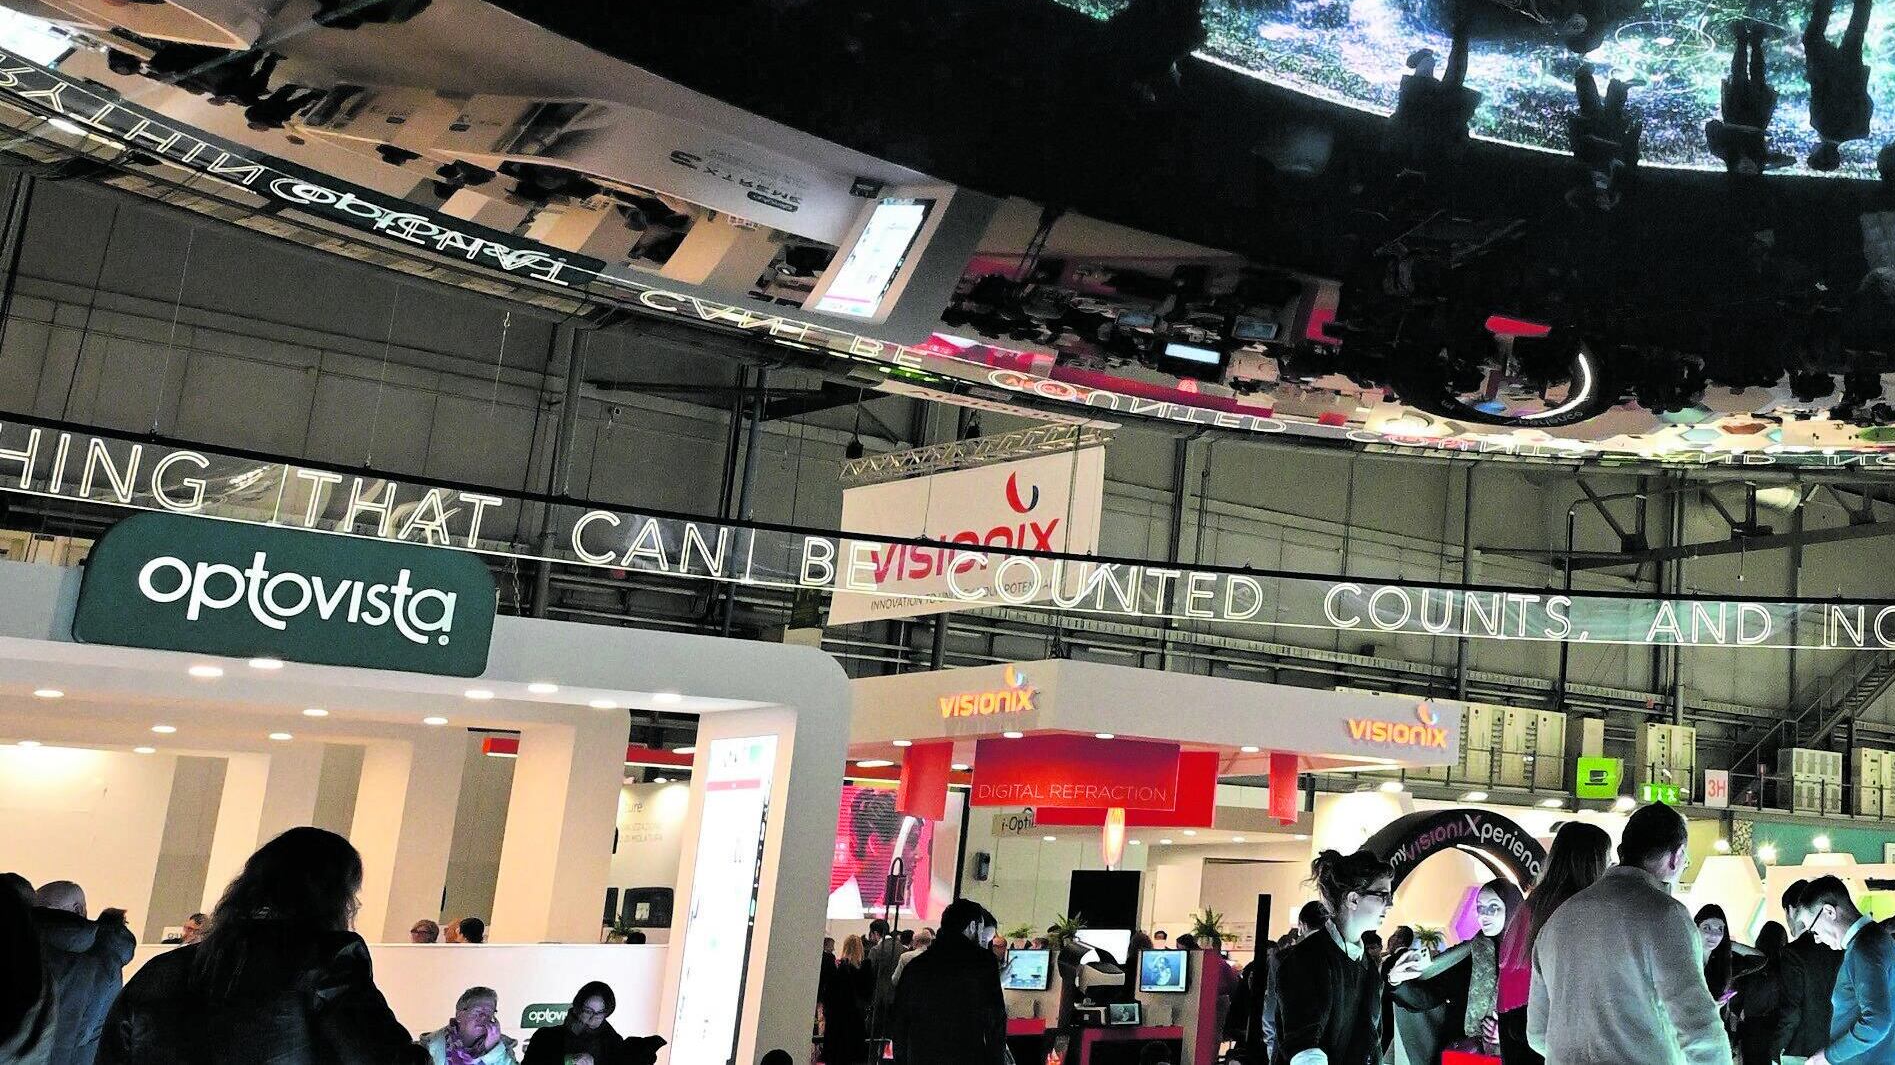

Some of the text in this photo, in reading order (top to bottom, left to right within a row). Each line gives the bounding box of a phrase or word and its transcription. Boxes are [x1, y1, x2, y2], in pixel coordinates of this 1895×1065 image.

[297, 468, 503, 549] THAT
[571, 510, 729, 577] CAN
[801, 536, 885, 591] BE
[945, 551, 1263, 619] COUNTED
[1646, 600, 1773, 644] AND
[138, 551, 458, 645] optovista
[978, 783, 1167, 802] DIGITAL REFRACTION
[1707, 779, 1727, 798] 3H
